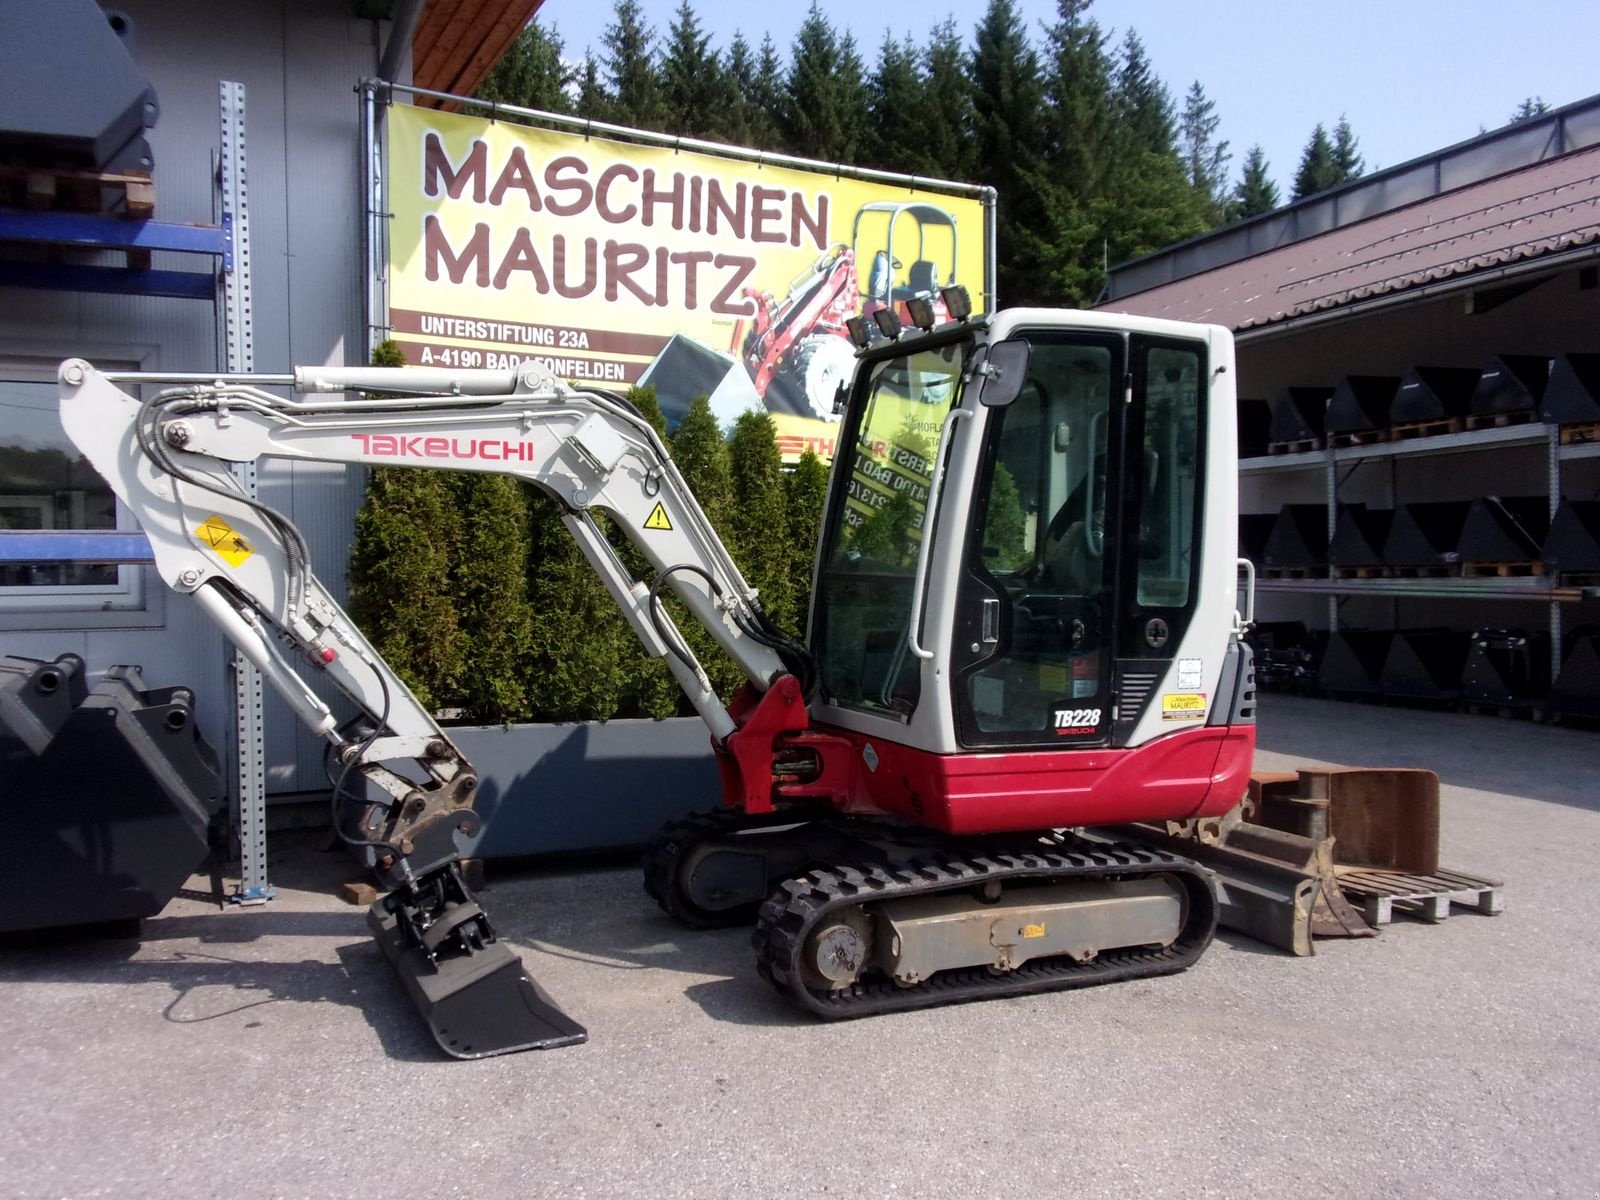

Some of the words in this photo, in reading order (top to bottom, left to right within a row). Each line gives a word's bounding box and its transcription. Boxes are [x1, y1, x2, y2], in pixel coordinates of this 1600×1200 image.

[424, 133, 829, 250] MASCHINEN
[425, 215, 758, 316] MAURITZ
[421, 316, 554, 346] UNTERSTIFTUNG
[559, 330, 589, 349] 23A
[421, 347, 481, 368] A-4190
[487, 356, 520, 370] BAD
[1054, 709, 1102, 728] TB228
